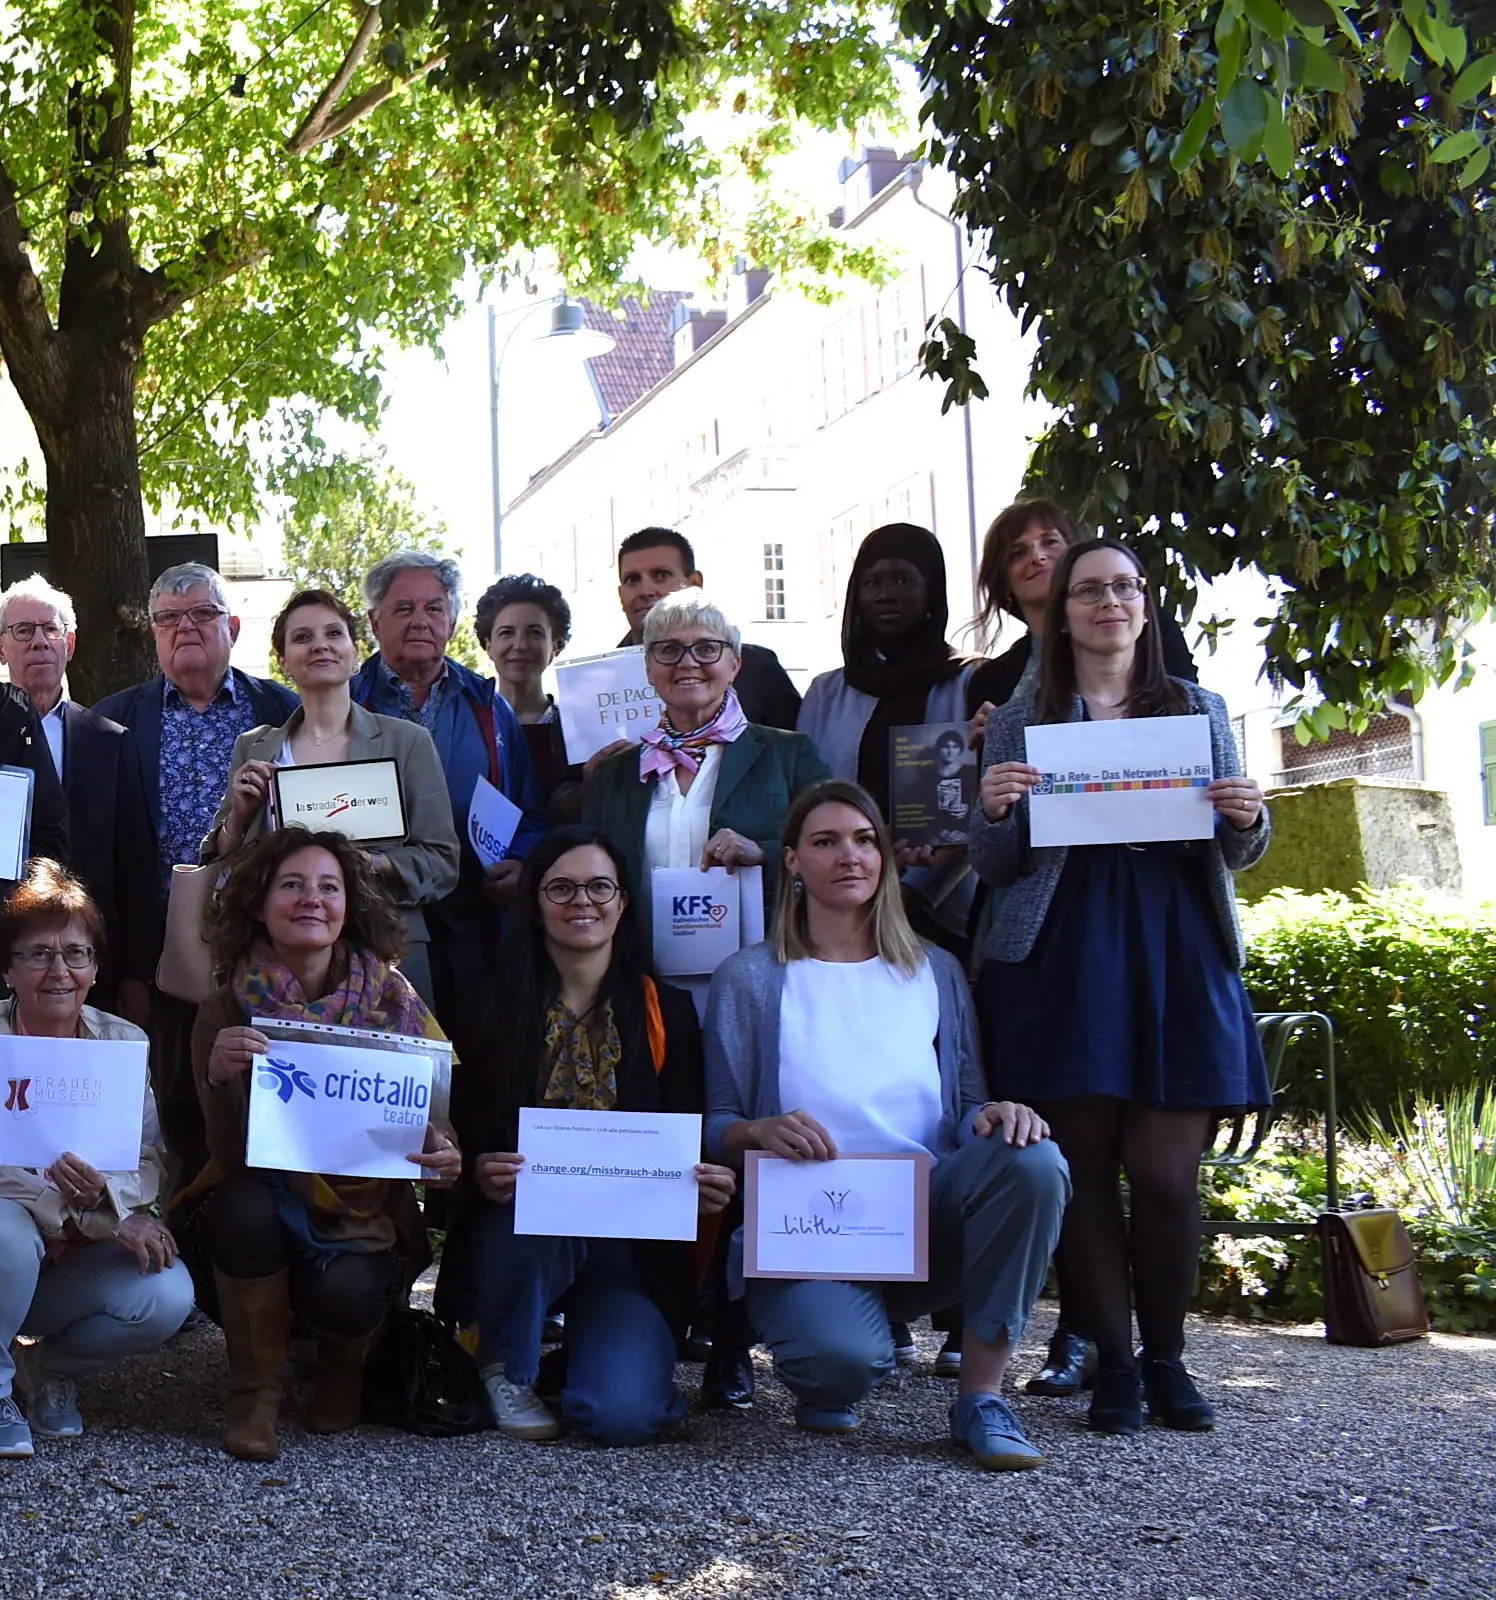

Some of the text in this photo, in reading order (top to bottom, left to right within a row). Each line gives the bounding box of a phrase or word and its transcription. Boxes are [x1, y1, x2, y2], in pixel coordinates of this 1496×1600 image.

[597, 692, 621, 708] DE
[1054, 773, 1066, 783] La
[1069, 771, 1091, 782] Rete
[1101, 770, 1120, 780] Das
[1123, 767, 1168, 779] Netzwerk
[1179, 766, 1192, 776] La
[296, 796, 388, 812] la strada der weg
[672, 895, 713, 916] KFS
[35, 1076, 102, 1090] FRAUEN
[324, 1069, 428, 1109] cristallo
[34, 1089, 102, 1101] MUSEUM
[384, 1106, 424, 1126] teatro
[531, 1163, 682, 1179] change.org/missbrauch-abuso
